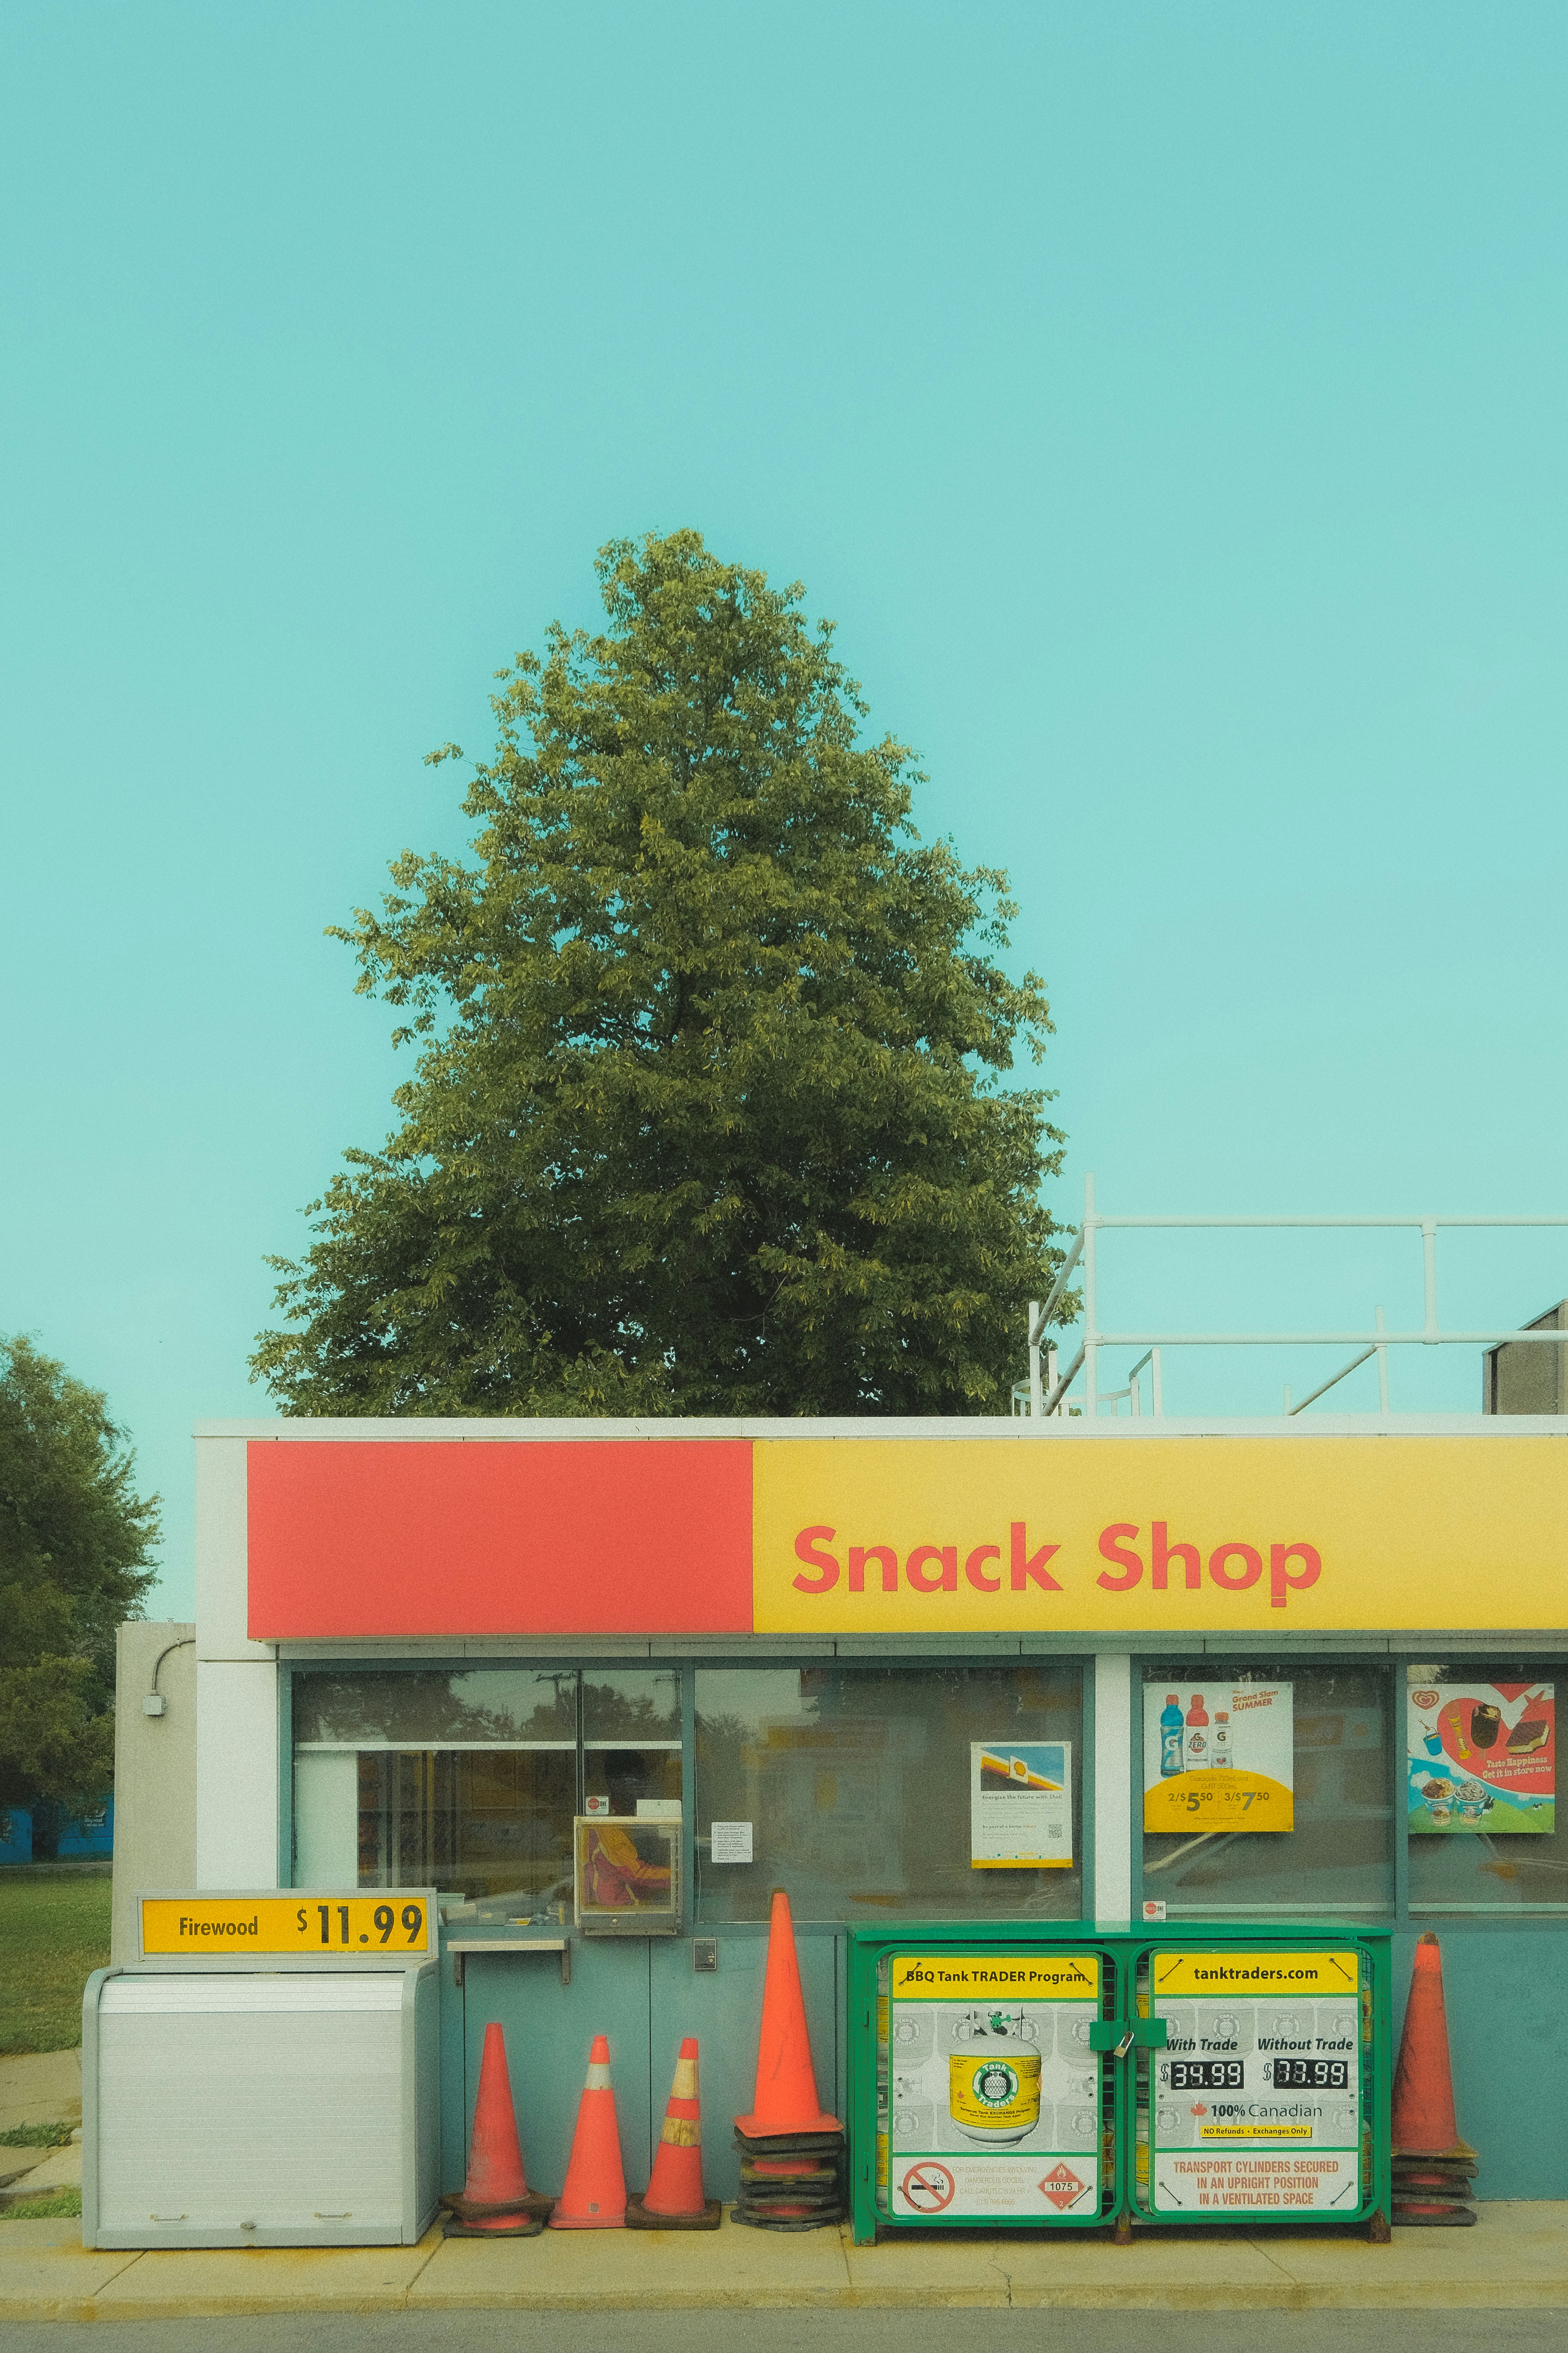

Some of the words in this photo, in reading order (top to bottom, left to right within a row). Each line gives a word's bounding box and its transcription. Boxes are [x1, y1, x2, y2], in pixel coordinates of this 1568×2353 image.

[792, 1522, 1064, 1593] Snack
[1096, 1521, 1322, 1608] Shop
[1233, 1693, 1257, 1703] Grand
[1233, 1698, 1273, 1712] SUMMER
[1486, 1760, 1506, 1768] Taste
[1506, 1756, 1548, 1767] Happiness
[1482, 1770, 1495, 1779] Get
[1496, 1769, 1503, 1778] it
[1504, 1768, 1512, 1777] in
[1513, 1766, 1534, 1775] store
[179, 1916, 258, 1936] Firewood
[906, 1971, 935, 1983] BBQ
[937, 1970, 969, 1982] Tank
[971, 1971, 1026, 1982] TRADER
[1029, 1971, 1085, 1985] Program
[1194, 1966, 1318, 1979] tanktraders.com
[1166, 2038, 1196, 2051] With
[1200, 2038, 1238, 2050] Trade
[1258, 2038, 1312, 2050] Without
[1315, 2038, 1354, 2050] Trade
[982, 2064, 1007, 2072] Tank
[978, 2094, 1015, 2108] Traders
[1211, 2104, 1246, 2117] 100%
[1249, 2104, 1322, 2117] Canadian
[1173, 2161, 1233, 2173] TRANSPORT
[1236, 2161, 1291, 2173] CYLINDERS
[1293, 2160, 1339, 2173] SECURED
[1050, 2183, 1073, 2191] 1075
[1197, 2177, 1207, 2189] IN
[1210, 2177, 1224, 2189] AN
[1227, 2177, 1271, 2189] UPRIGHT
[1273, 2176, 1319, 2189] POSITION
[1199, 2193, 1210, 2205] IN
[1212, 2193, 1220, 2205] A
[1222, 2192, 1280, 2205] VENTILATED
[1283, 2192, 1314, 2205] SPACE
